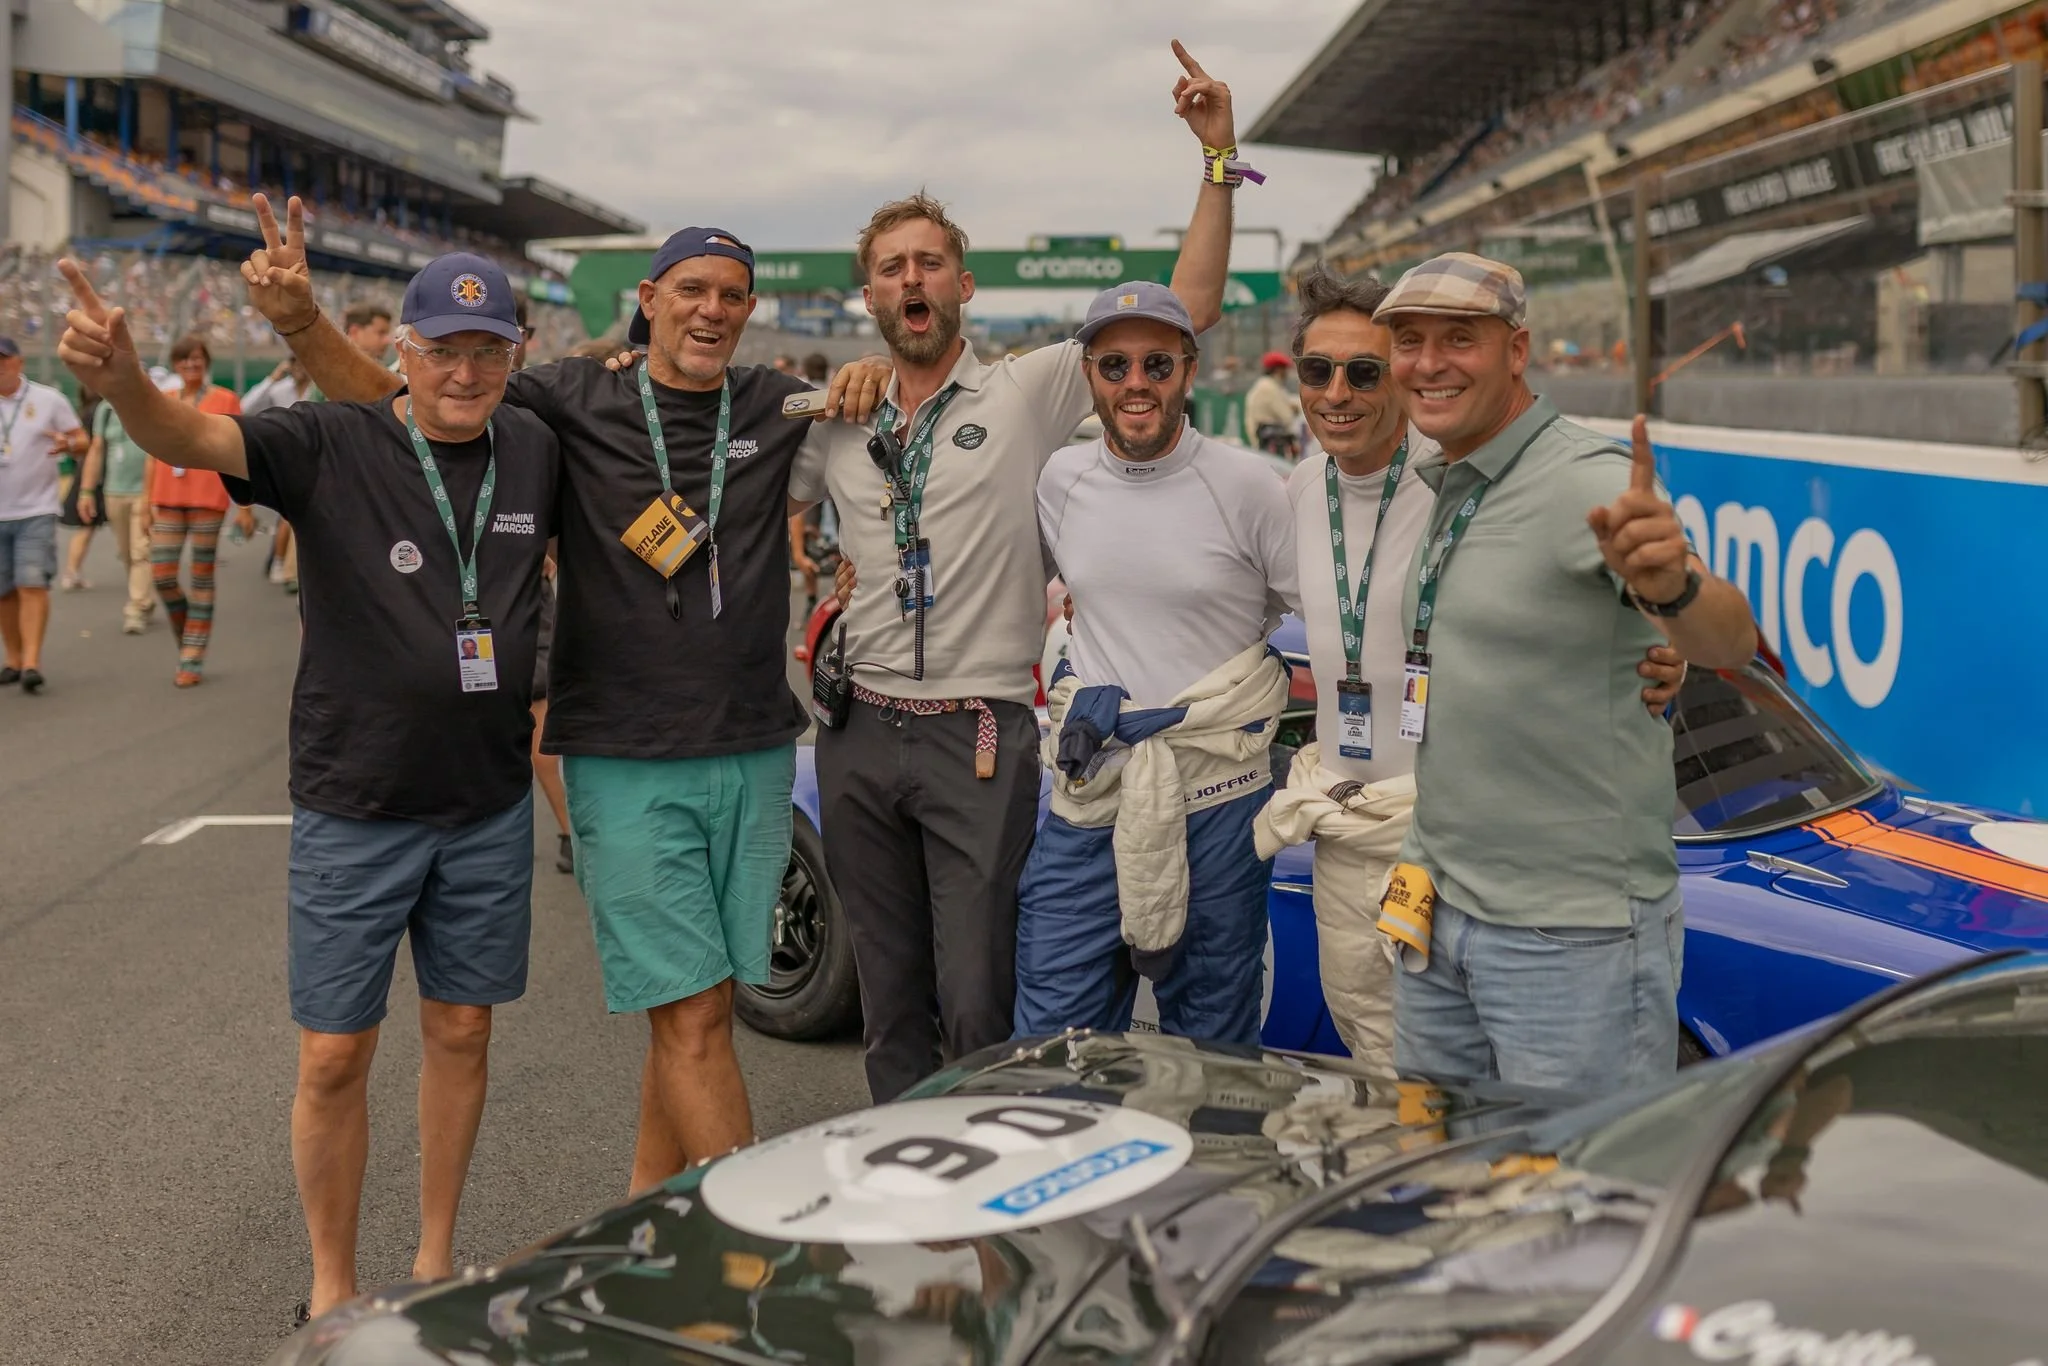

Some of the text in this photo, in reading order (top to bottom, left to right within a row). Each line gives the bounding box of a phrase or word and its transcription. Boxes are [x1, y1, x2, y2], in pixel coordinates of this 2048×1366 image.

[1016, 256, 1124, 279] aramco
[732, 440, 757, 450] MINI
[711, 446, 759, 458] RCOS
[512, 513, 534, 524] MINI
[492, 522, 536, 535] MARCOS
[635, 515, 672, 556] PITLANE
[1194, 769, 1259, 800] JOFFRE
